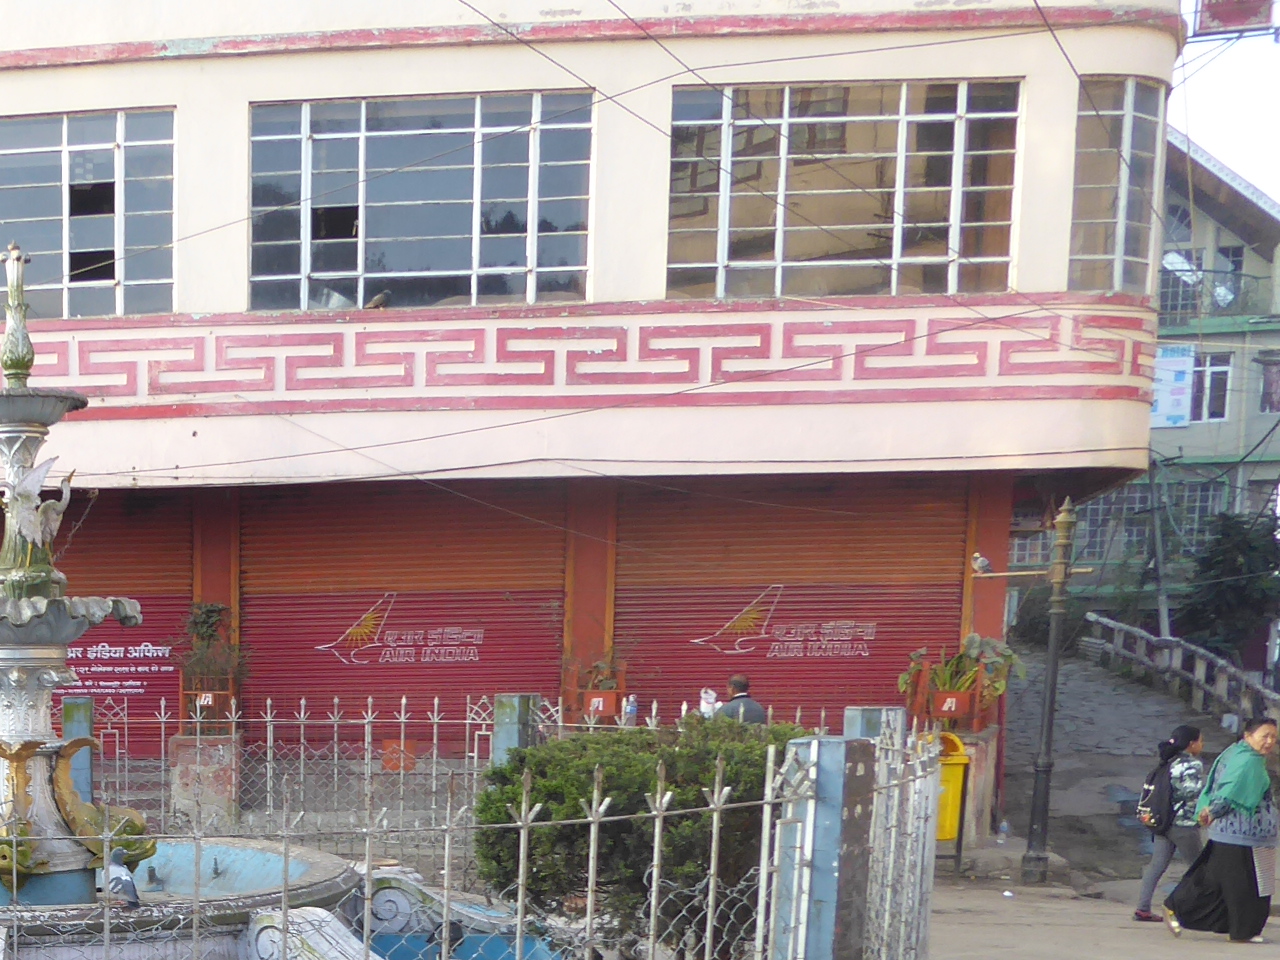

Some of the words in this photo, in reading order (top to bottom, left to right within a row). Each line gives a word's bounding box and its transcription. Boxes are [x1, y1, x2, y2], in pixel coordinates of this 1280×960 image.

[379, 647, 415, 662] AIR
[421, 646, 479, 662] INDIA
[766, 642, 803, 657] AIR
[807, 641, 869, 656] INDIA
